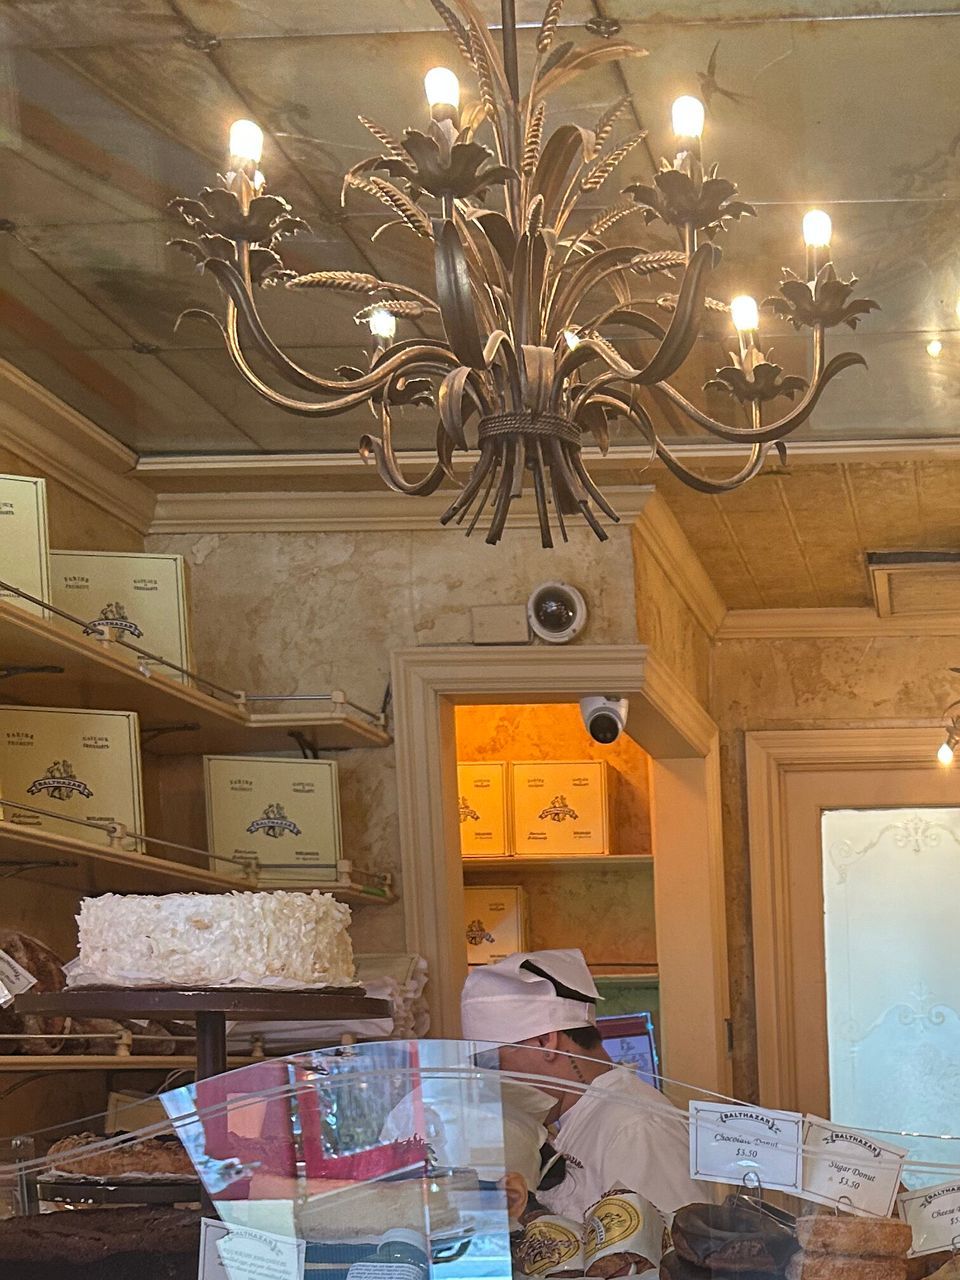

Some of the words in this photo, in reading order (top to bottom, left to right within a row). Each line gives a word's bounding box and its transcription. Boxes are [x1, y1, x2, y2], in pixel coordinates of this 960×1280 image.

[38, 780, 83, 788] BALTHAZAR
[723, 1112, 771, 1126] BALTHAZAR
[834, 1132, 878, 1153] BALTHAZAR
[736, 1148, 757, 1158] $3.50
[829, 1160, 851, 1173] Sugar
[851, 1166, 876, 1182] Donut
[838, 1176, 861, 1190] $3.50
[931, 1208, 955, 1219] Cheese
